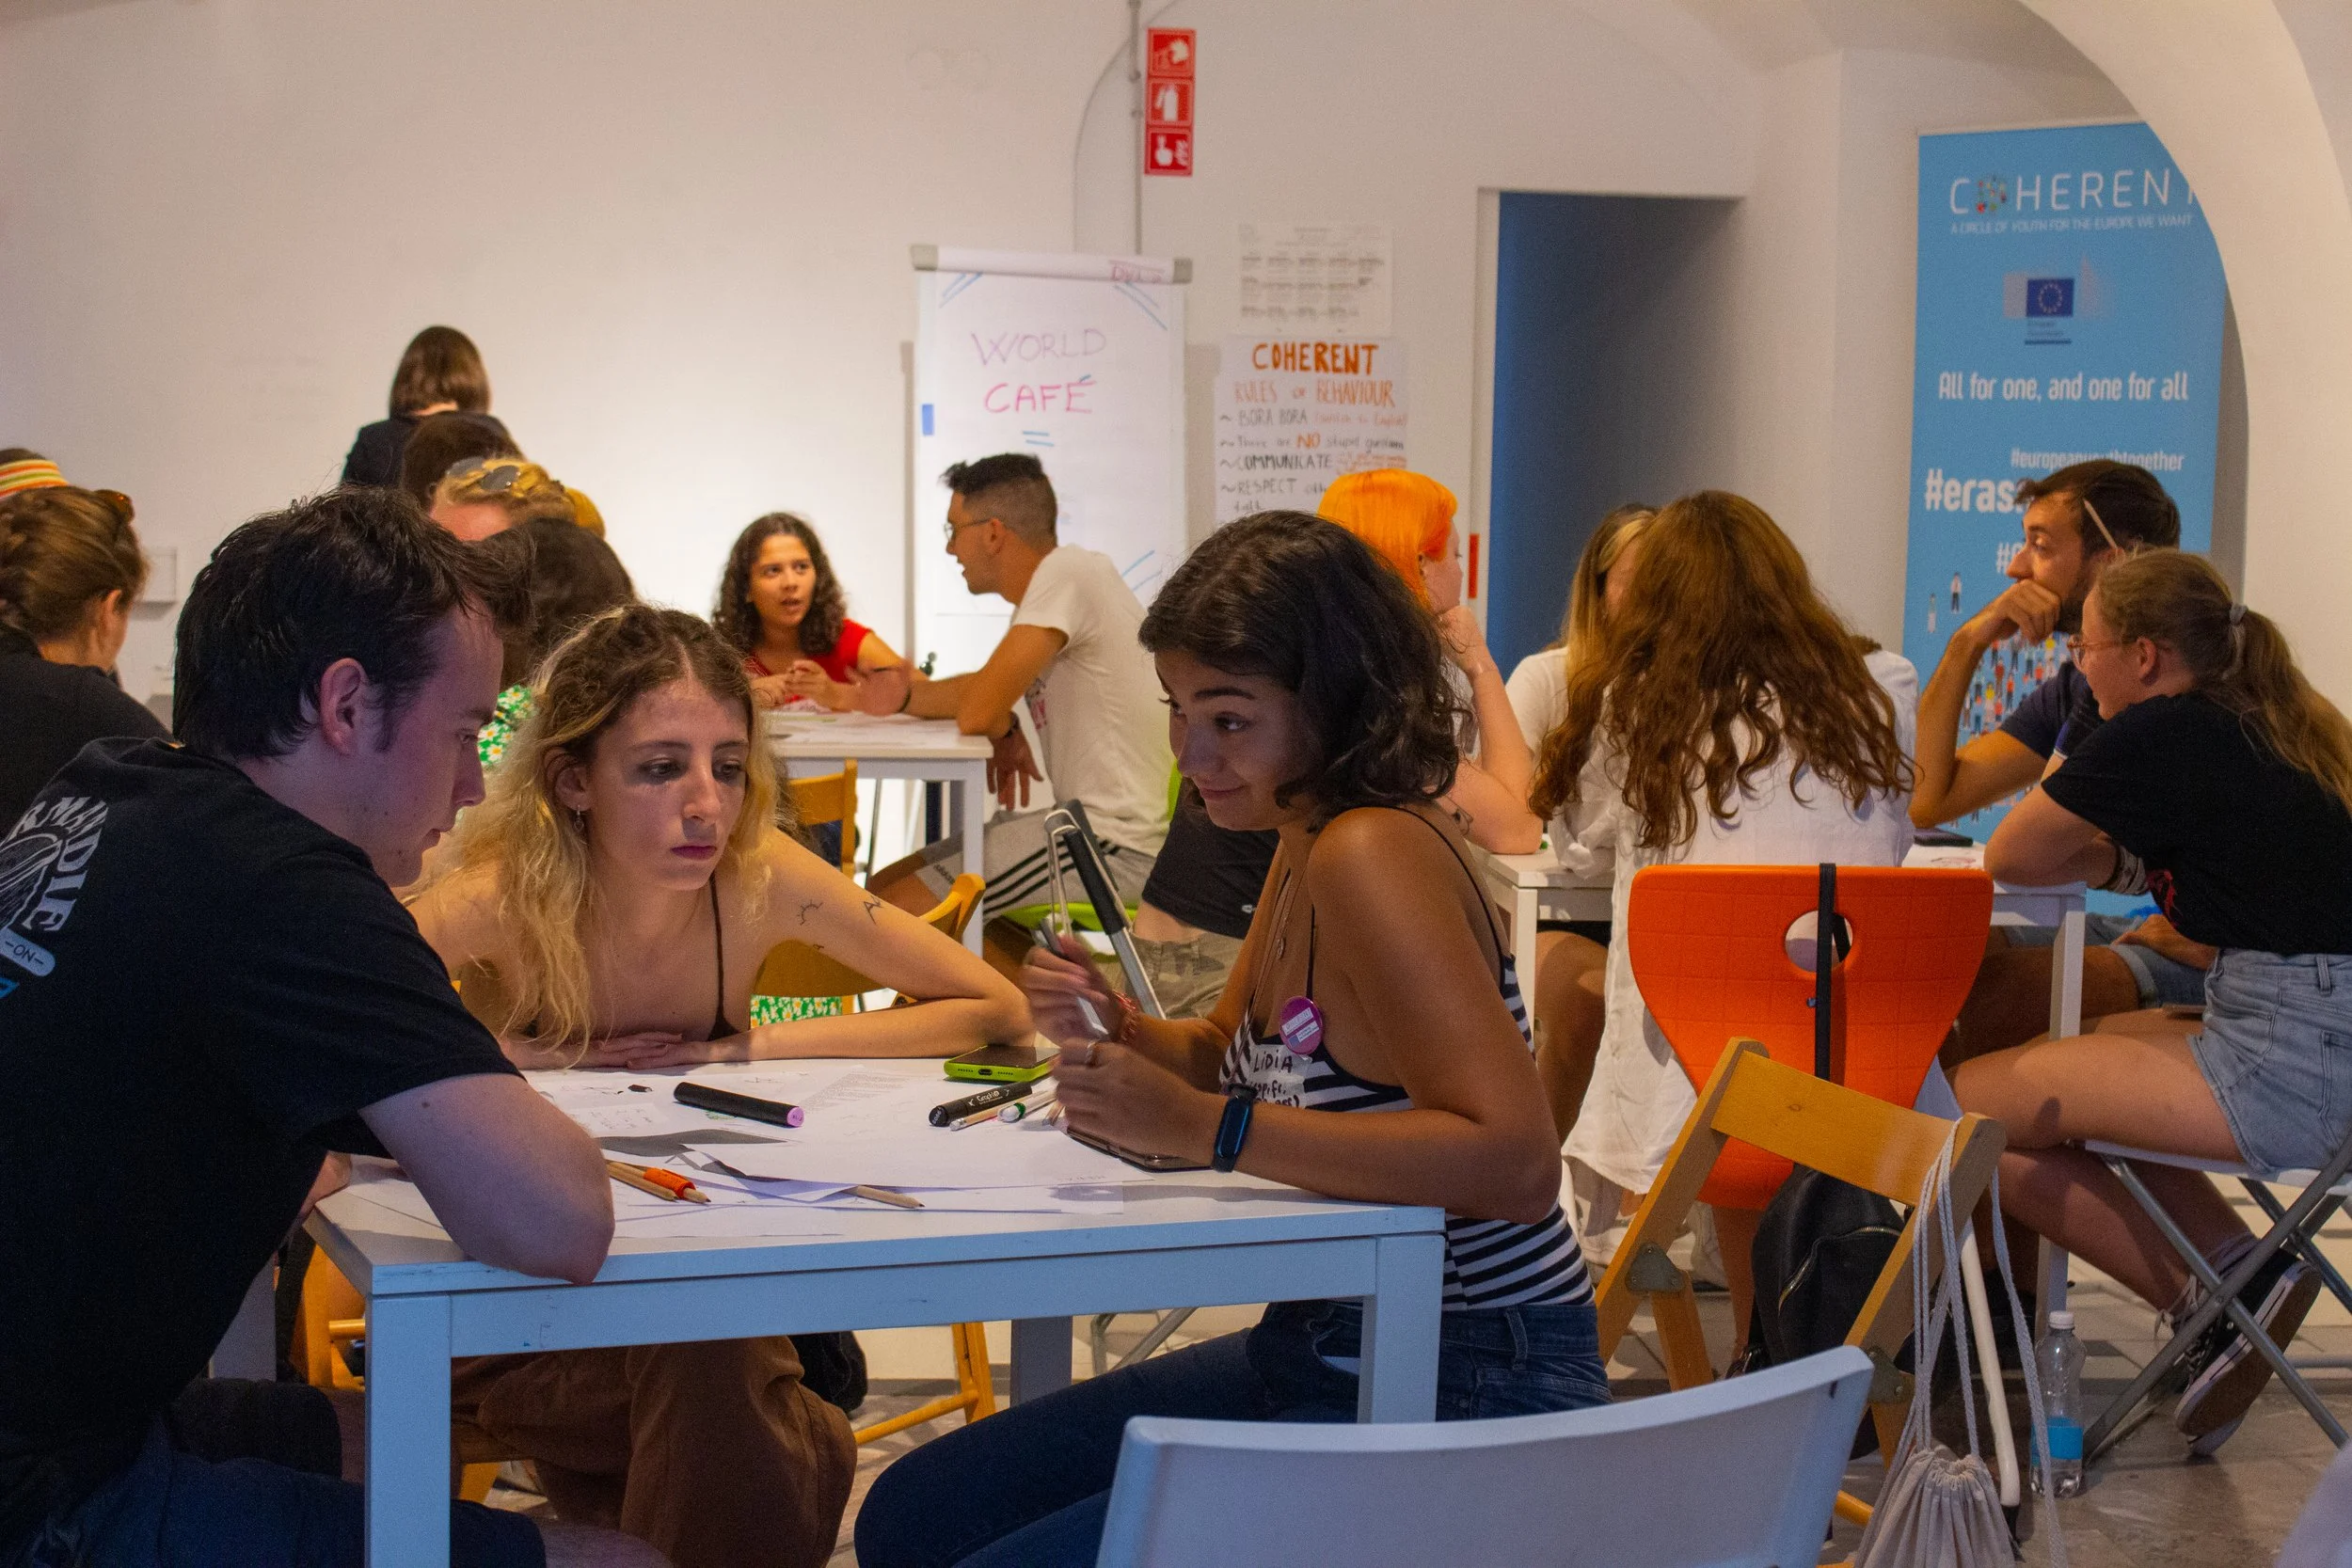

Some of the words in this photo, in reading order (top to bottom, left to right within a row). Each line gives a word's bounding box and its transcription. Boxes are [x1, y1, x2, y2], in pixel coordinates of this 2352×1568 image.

[1960, 222, 1992, 235] CIRCLE
[2011, 220, 2047, 233] YOUTH
[2048, 218, 2070, 232] FOR
[2072, 217, 2091, 230] THE
[2094, 215, 2134, 230] EUROPE
[2136, 214, 2154, 228] WE
[2157, 214, 2193, 228] WANT
[971, 328, 1106, 365] WORLD
[1252, 342, 1379, 374] COHERENT
[984, 374, 1097, 413] CAFÉ
[1233, 380, 1278, 404] RULES
[1316, 380, 1396, 407] BEHAVIOUR
[1938, 372, 1963, 400] All
[1969, 372, 1995, 400] for
[2002, 377, 2042, 404] one,
[2047, 372, 2083, 401] and
[2088, 378, 2122, 401] one
[2127, 372, 2155, 401] for
[2160, 372, 2189, 401] all
[1238, 409, 1273, 426] BORA
[1279, 408, 1308, 425] BORA
[1296, 433, 1321, 449] NO
[1237, 453, 1332, 471] COMMUNICATE
[1237, 478, 1296, 495] RESPECT
[1925, 468, 2030, 514] #eras
